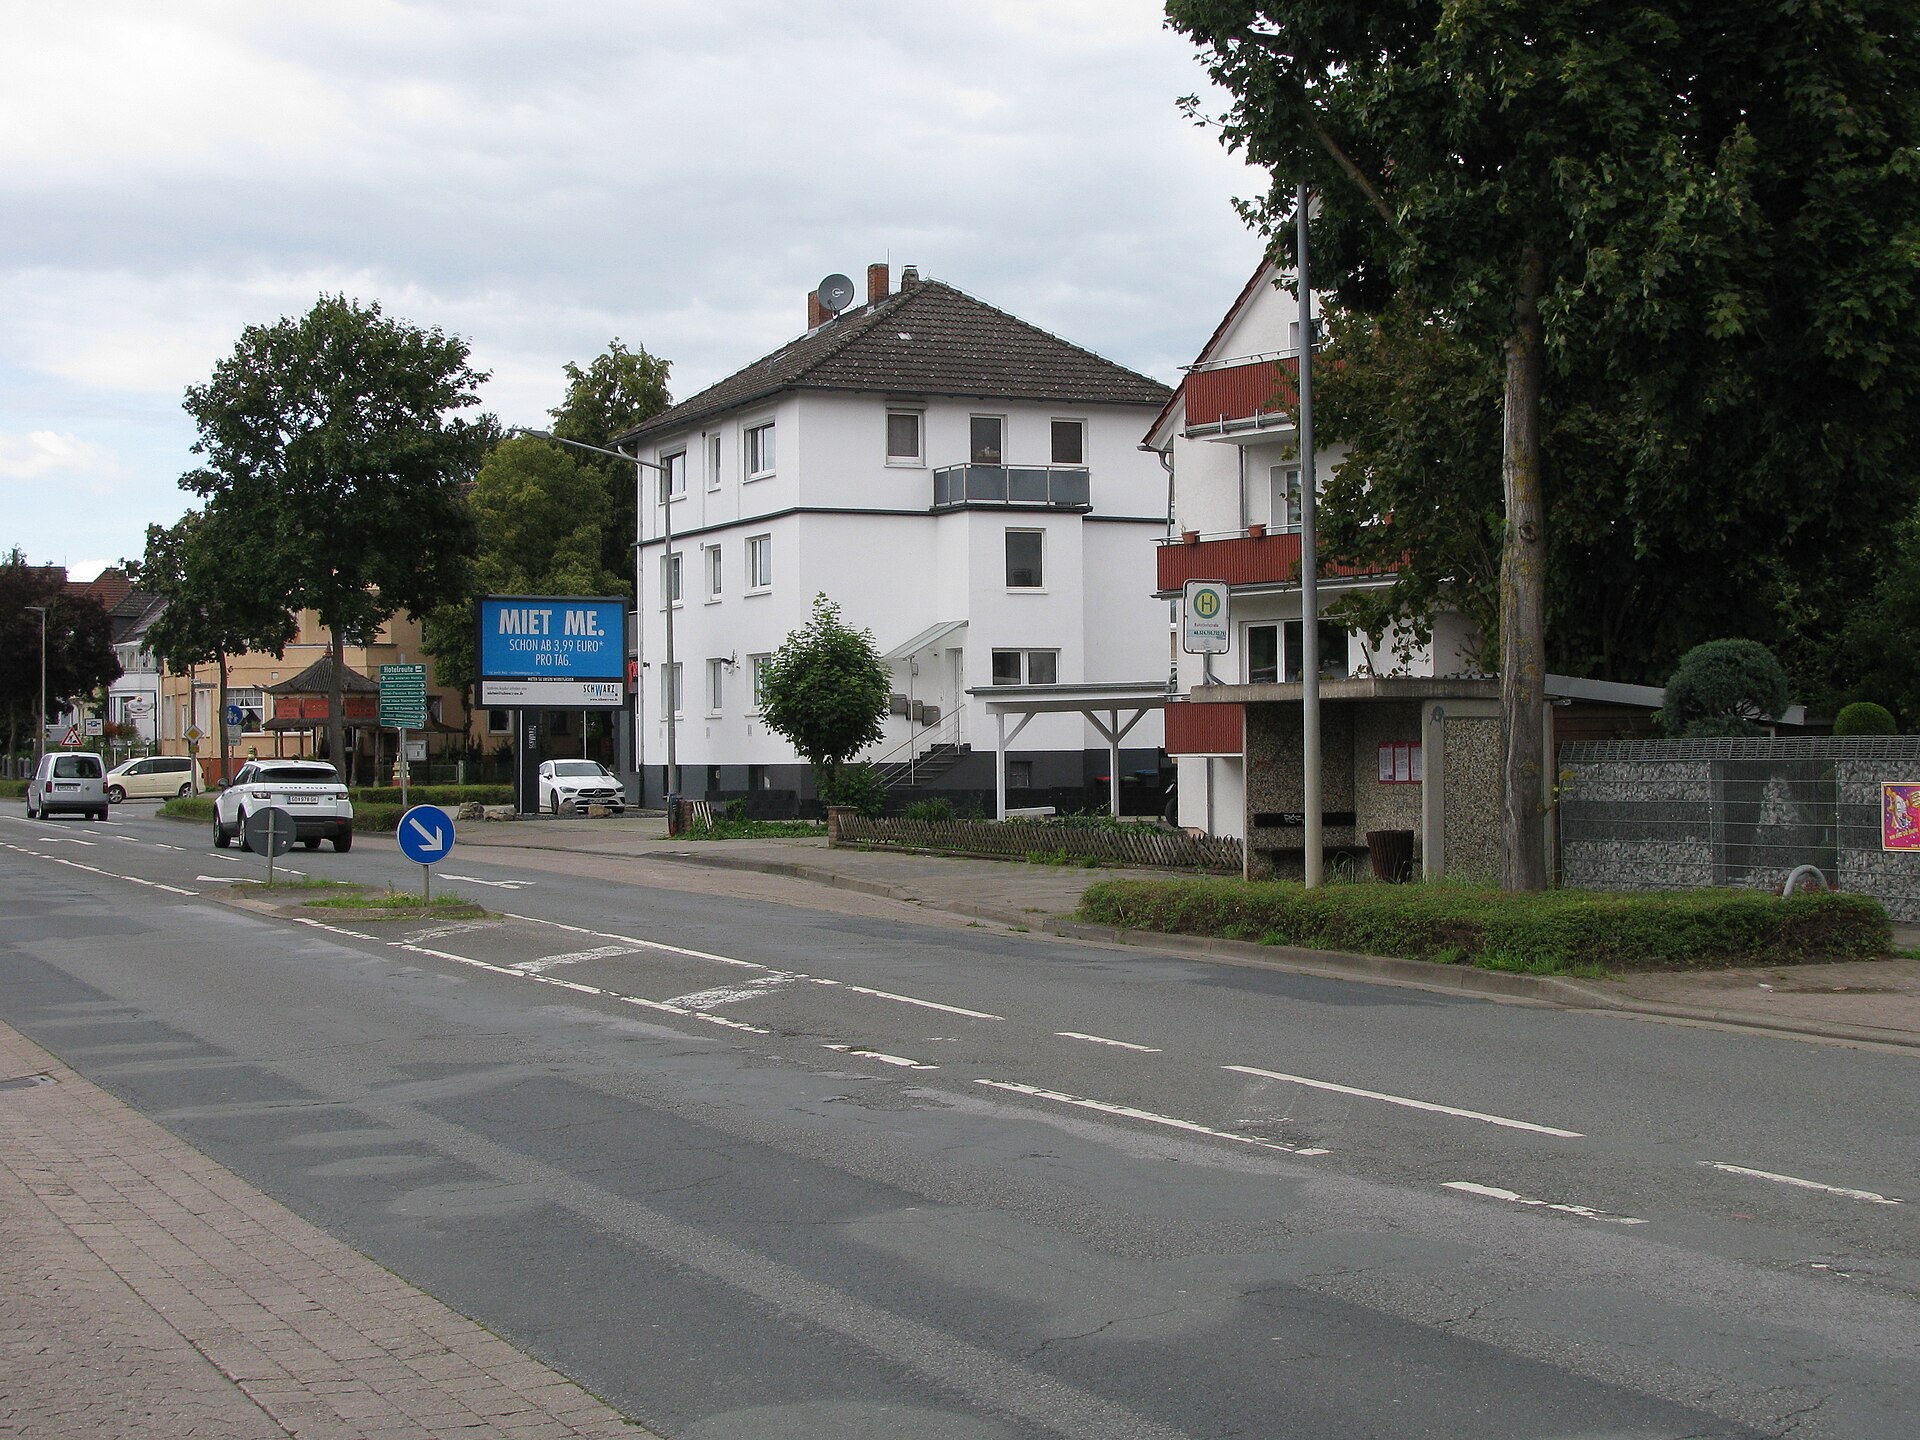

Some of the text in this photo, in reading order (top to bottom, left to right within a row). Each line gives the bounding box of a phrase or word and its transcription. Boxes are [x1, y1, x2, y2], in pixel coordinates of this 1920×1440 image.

[1201, 596, 1212, 612] H
[498, 608, 604, 636] MIET ME.
[509, 638, 538, 651] SCHON
[541, 639, 552, 651] AB
[554, 640, 574, 653] 3,99
[535, 653, 572, 667] PRO TAG.
